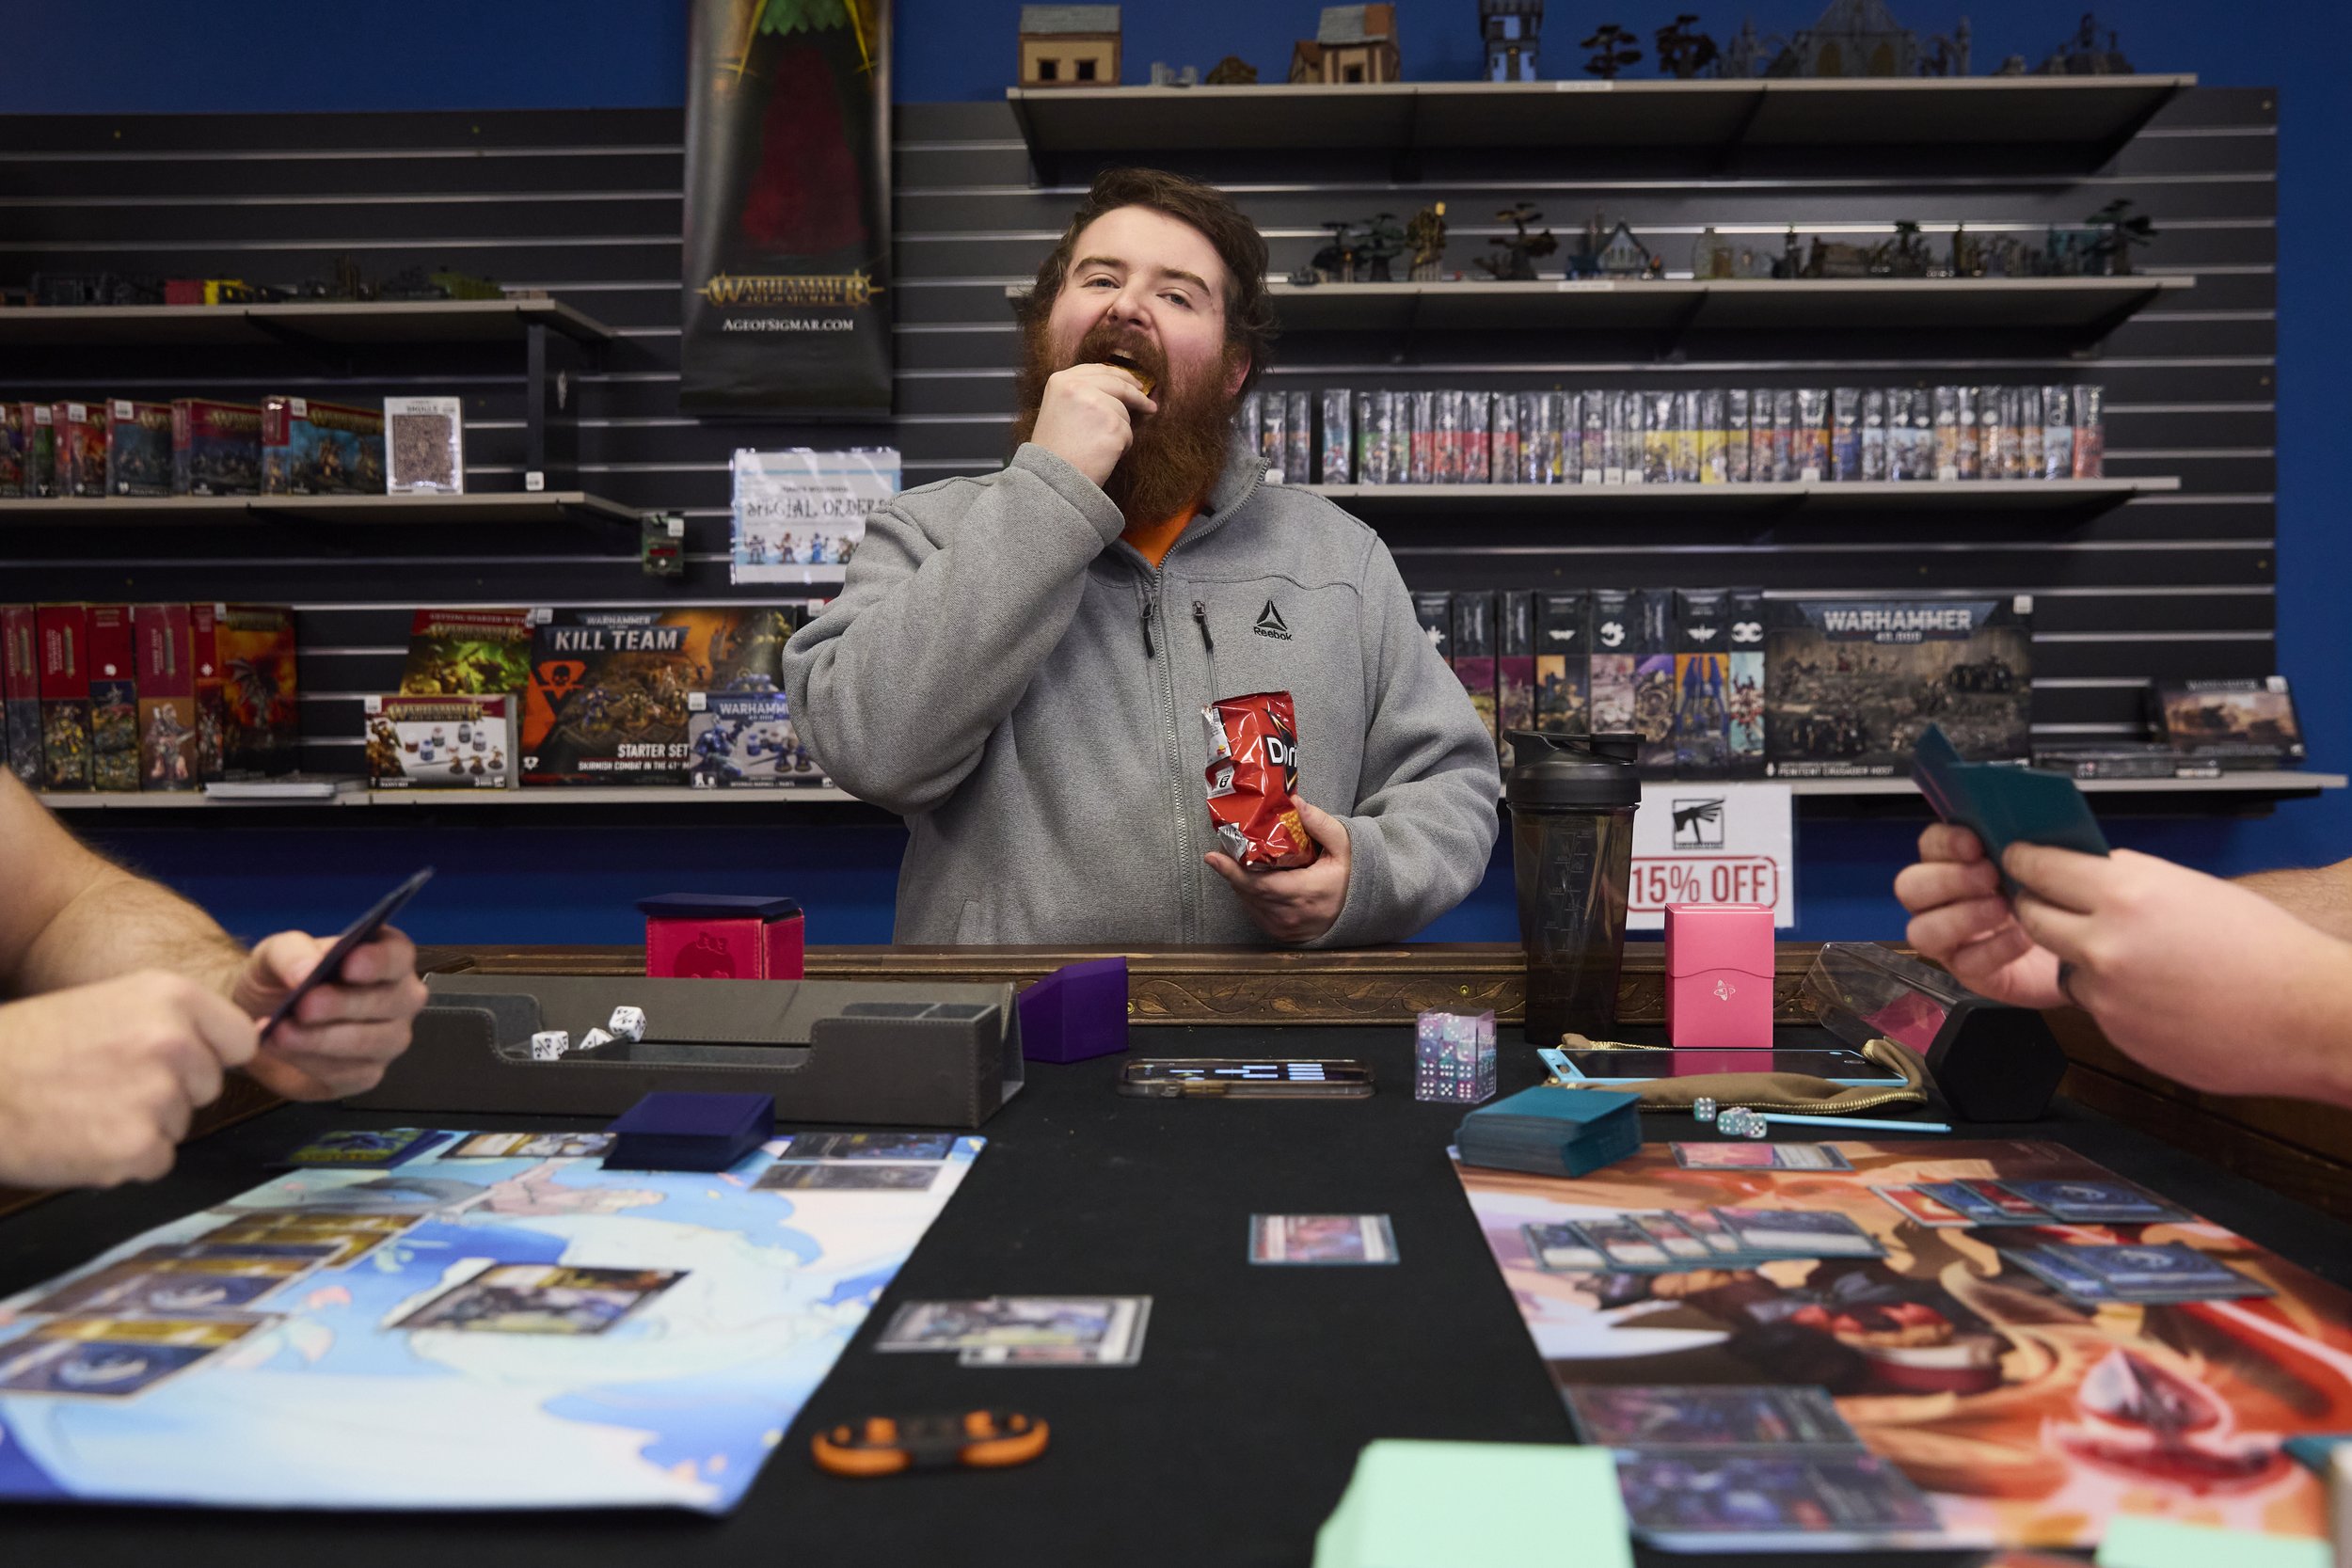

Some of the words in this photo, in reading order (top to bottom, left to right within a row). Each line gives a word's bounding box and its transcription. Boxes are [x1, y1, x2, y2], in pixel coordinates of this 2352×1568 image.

[587, 615, 651, 626] WARHAMMER
[1823, 610, 1972, 631] WARHAMMER
[555, 630, 605, 651] KILL
[612, 630, 678, 650] TEAM
[1253, 626, 1292, 641] Reebok
[617, 743, 665, 758] STARTER
[668, 743, 691, 758] SET
[578, 760, 613, 771] SKIRMISH
[613, 760, 643, 770] COMBAT
[1632, 865, 1700, 903] 15%
[1711, 865, 1767, 902] OFF
